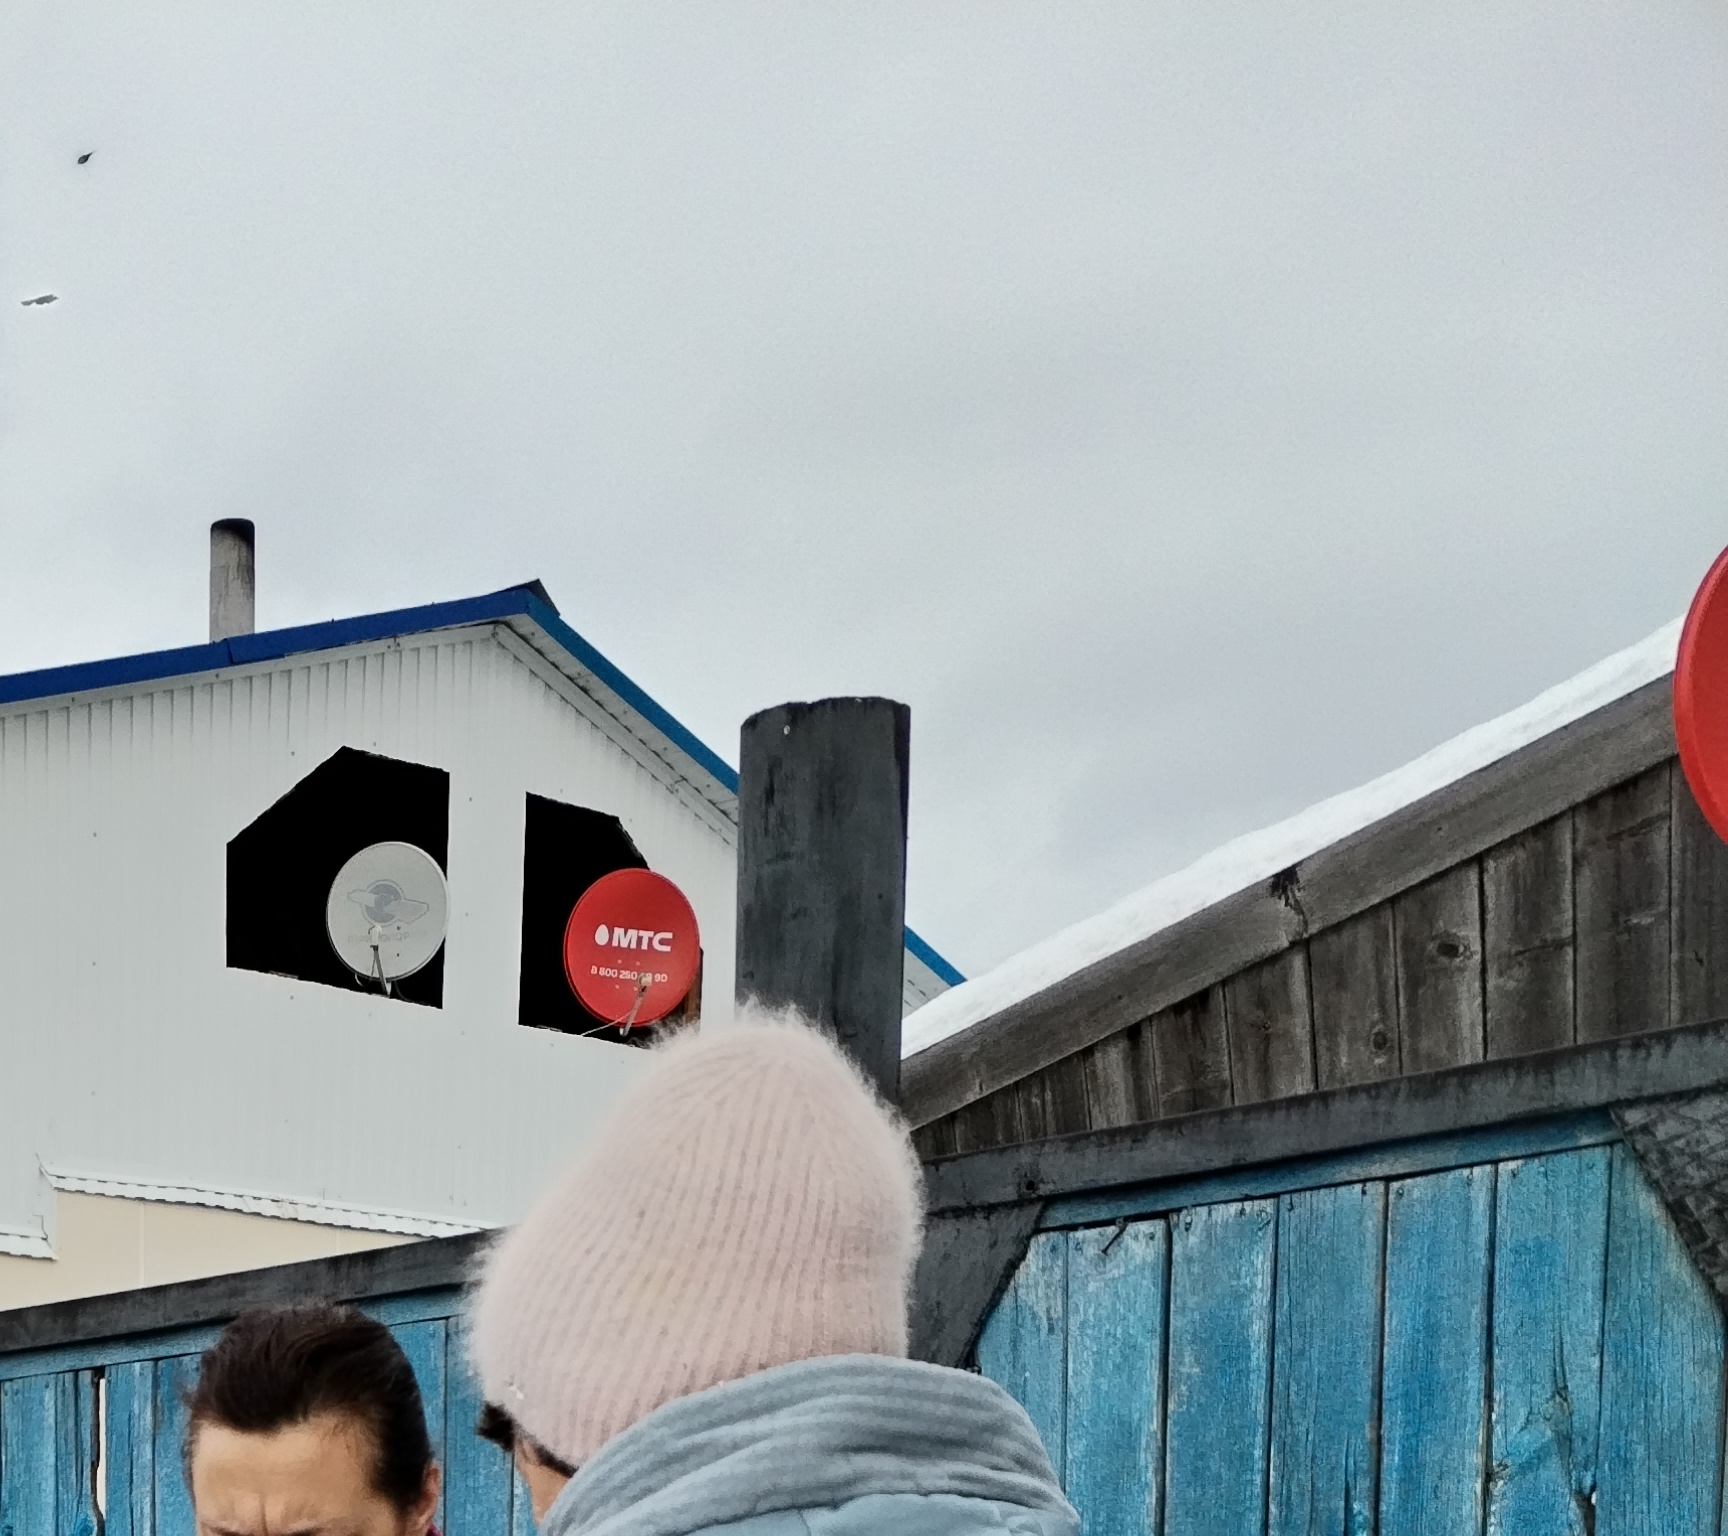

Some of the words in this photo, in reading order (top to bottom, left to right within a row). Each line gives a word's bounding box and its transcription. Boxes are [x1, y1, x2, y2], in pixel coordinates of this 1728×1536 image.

[612, 927, 673, 952] МТС
[591, 965, 598, 975] 8
[599, 967, 618, 977] 800
[619, 970, 638, 981] 250
